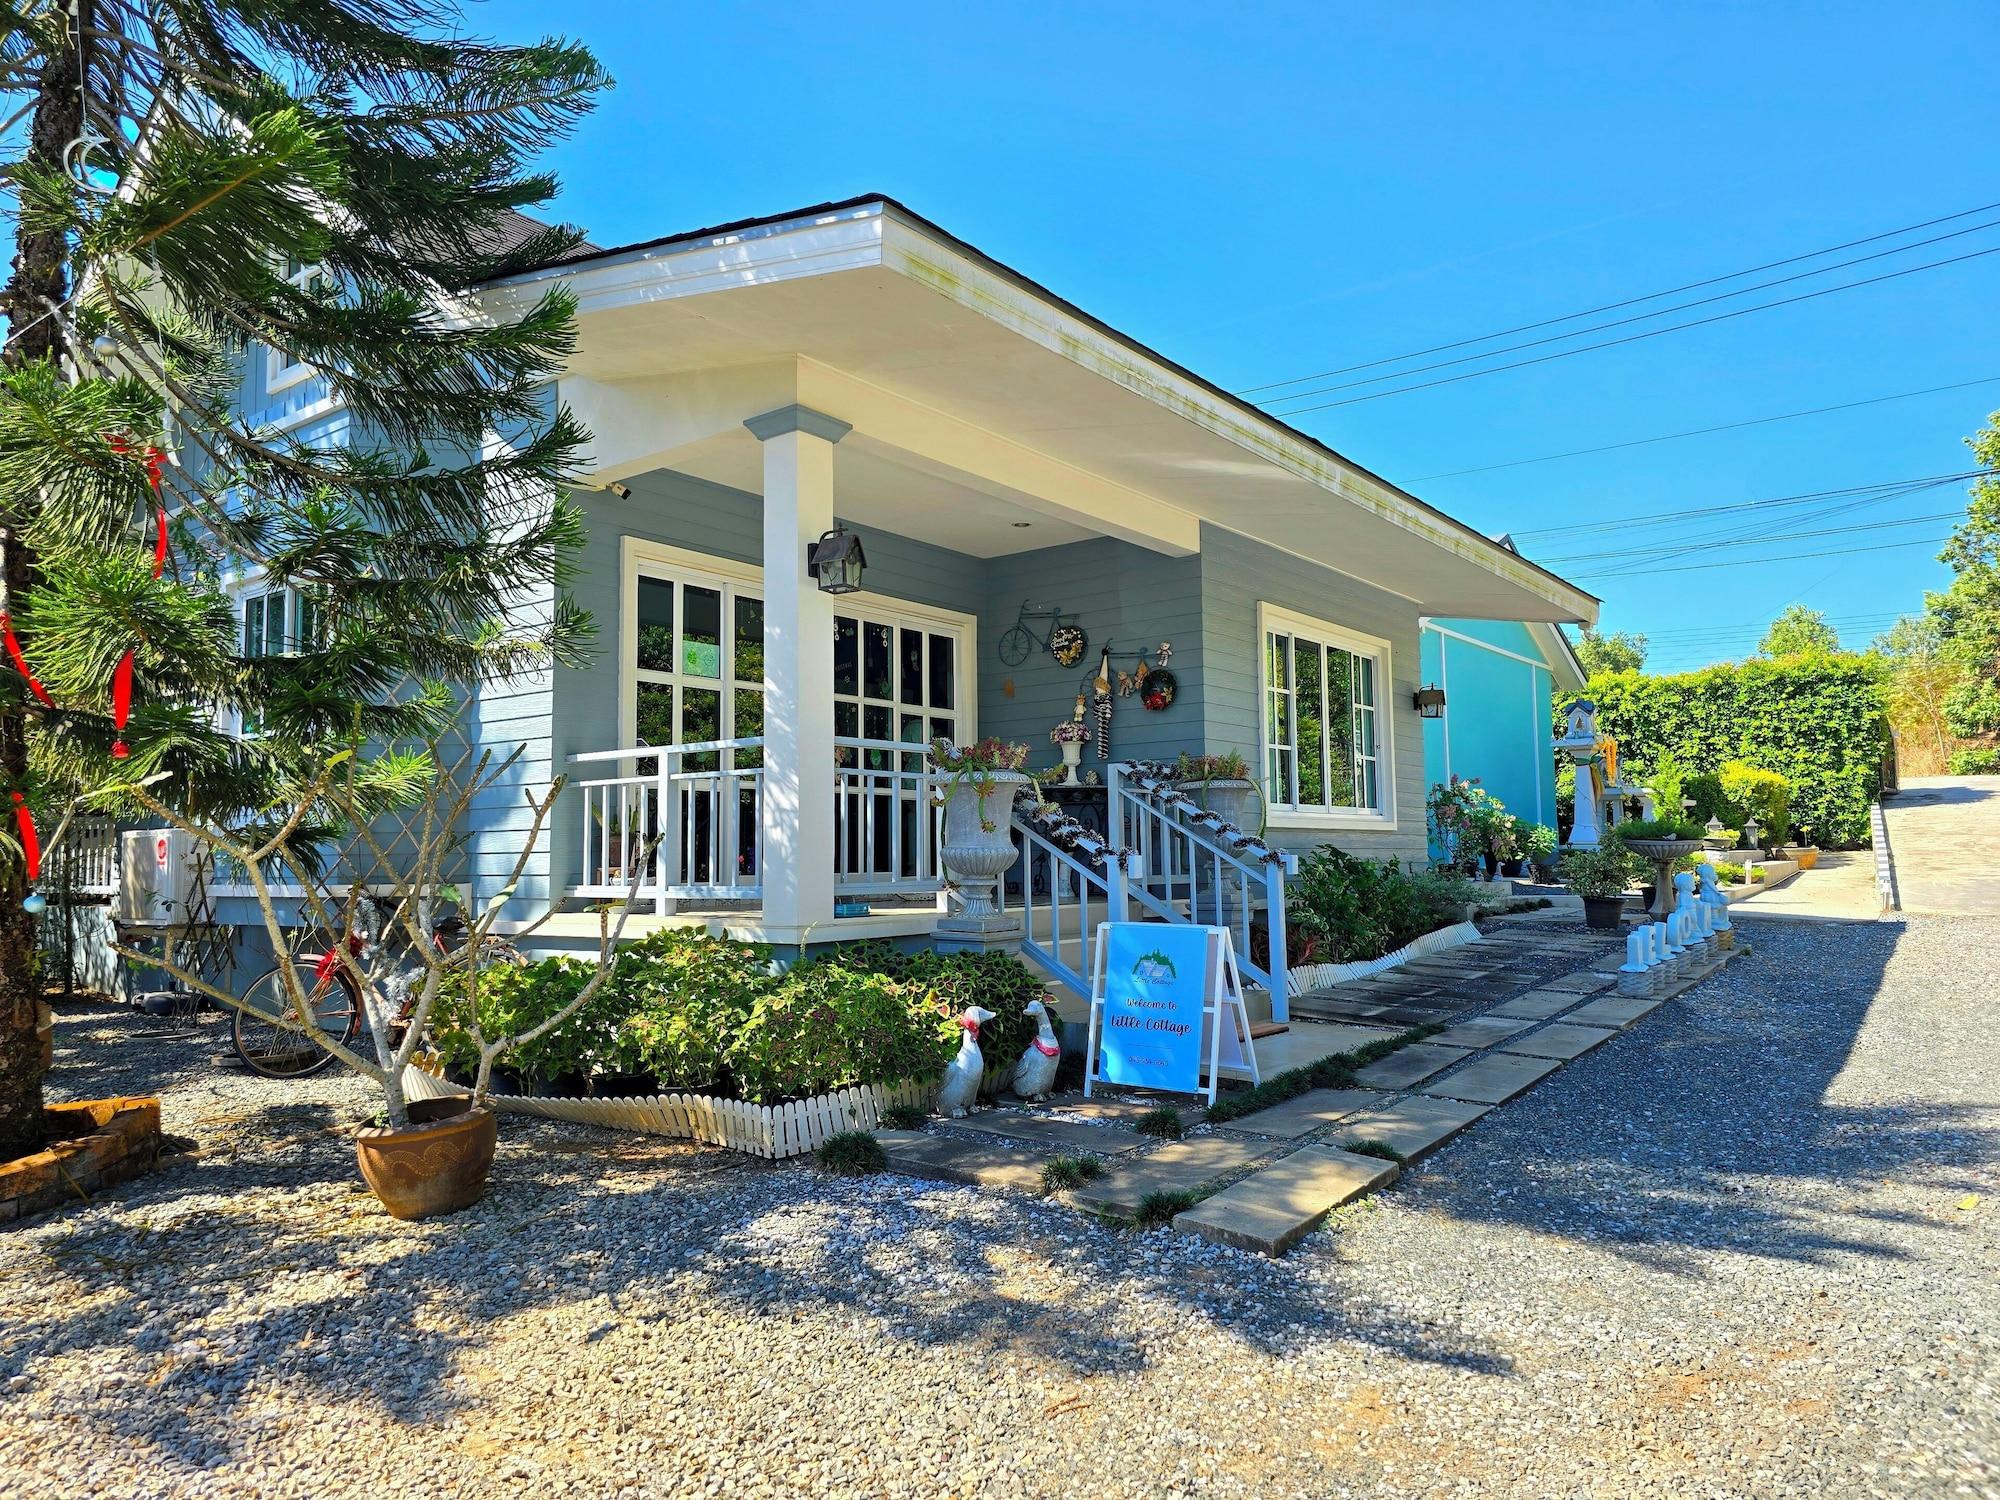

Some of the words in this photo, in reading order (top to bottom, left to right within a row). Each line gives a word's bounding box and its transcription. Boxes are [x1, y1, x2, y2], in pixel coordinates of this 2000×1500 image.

[1127, 998, 1167, 1010] Welcome
[1168, 1000, 1177, 1011] to
[1146, 1017, 1192, 1037] Cottage
